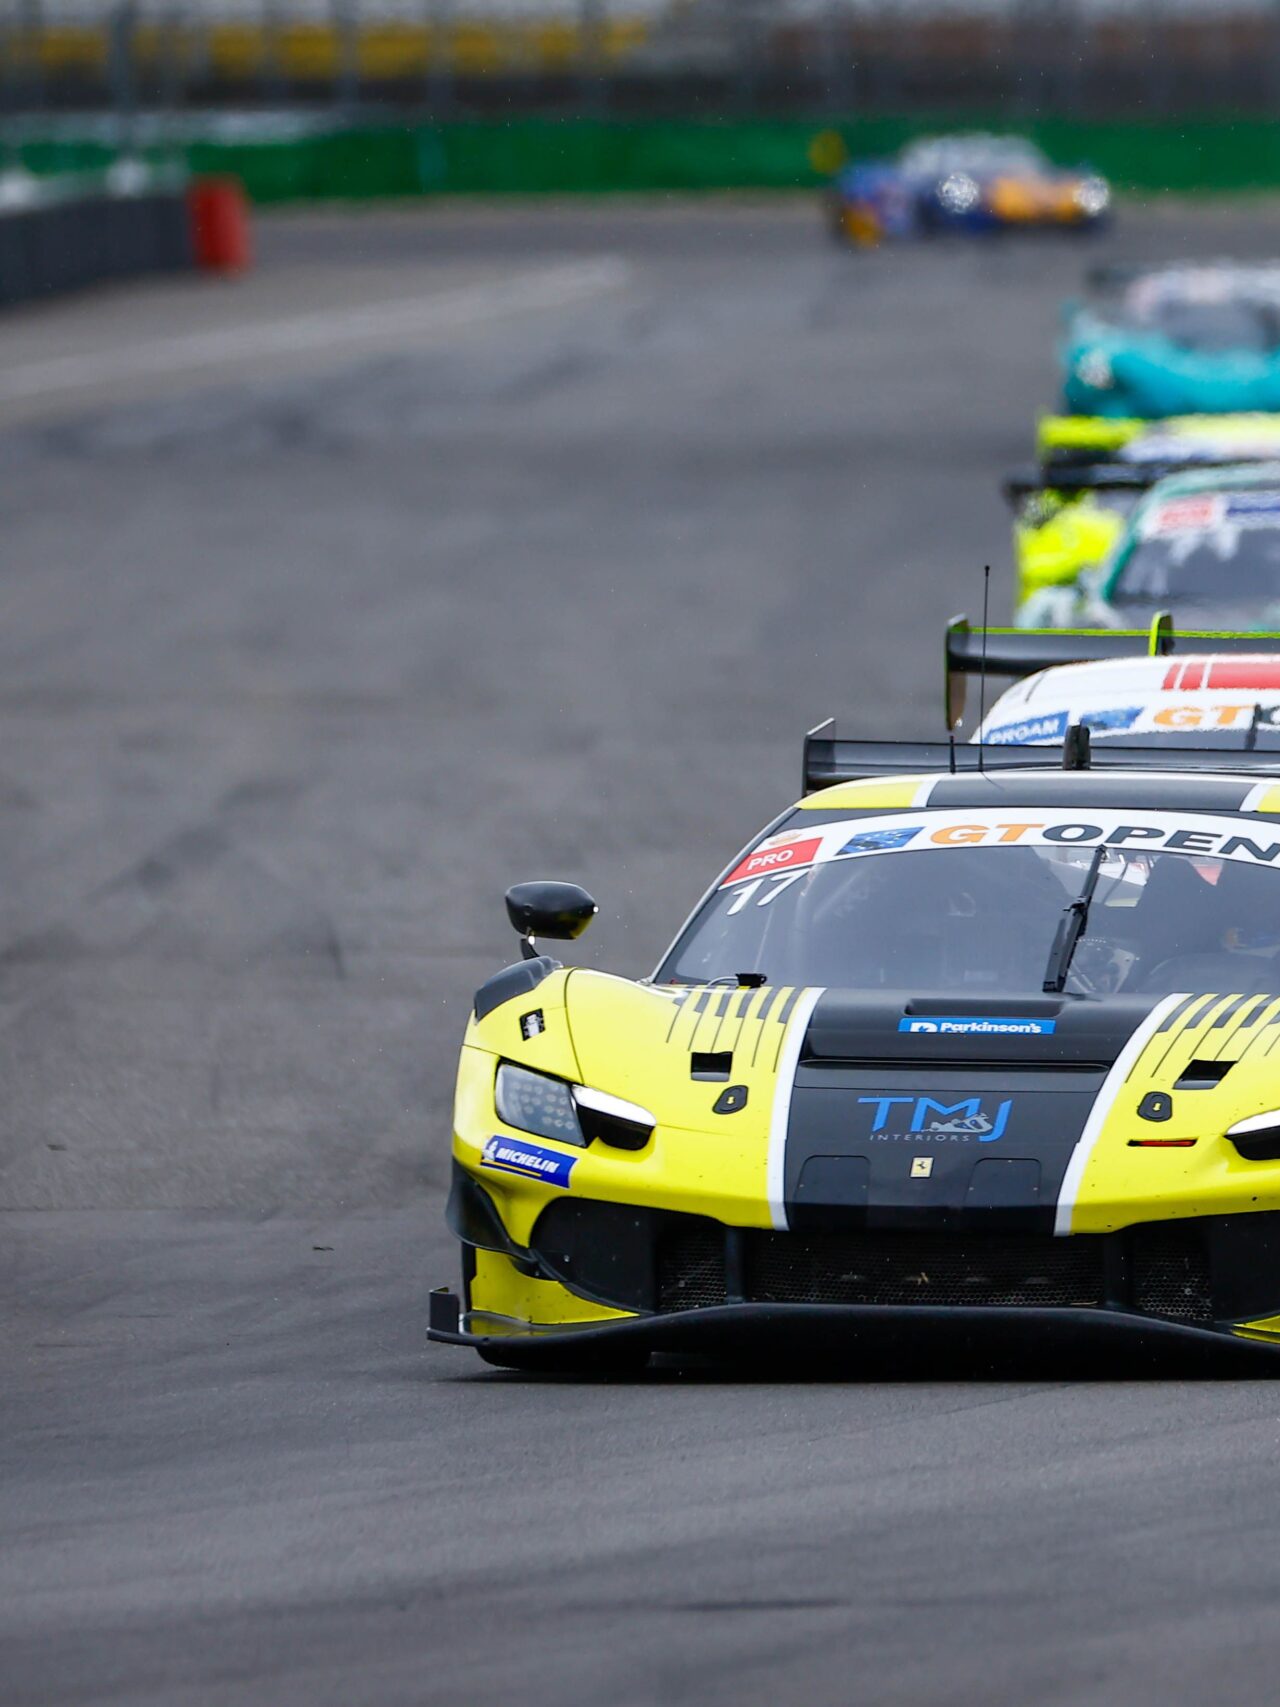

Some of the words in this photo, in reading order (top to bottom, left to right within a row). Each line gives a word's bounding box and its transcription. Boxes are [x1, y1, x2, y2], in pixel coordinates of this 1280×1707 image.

[746, 850, 794, 871] PRO
[726, 868, 811, 916] 17
[940, 1021, 1042, 1034] Parkinson's
[857, 1097, 1014, 1142] TMJ
[869, 1134, 970, 1142] INTERIORS
[496, 1147, 561, 1174] MICHELIN
